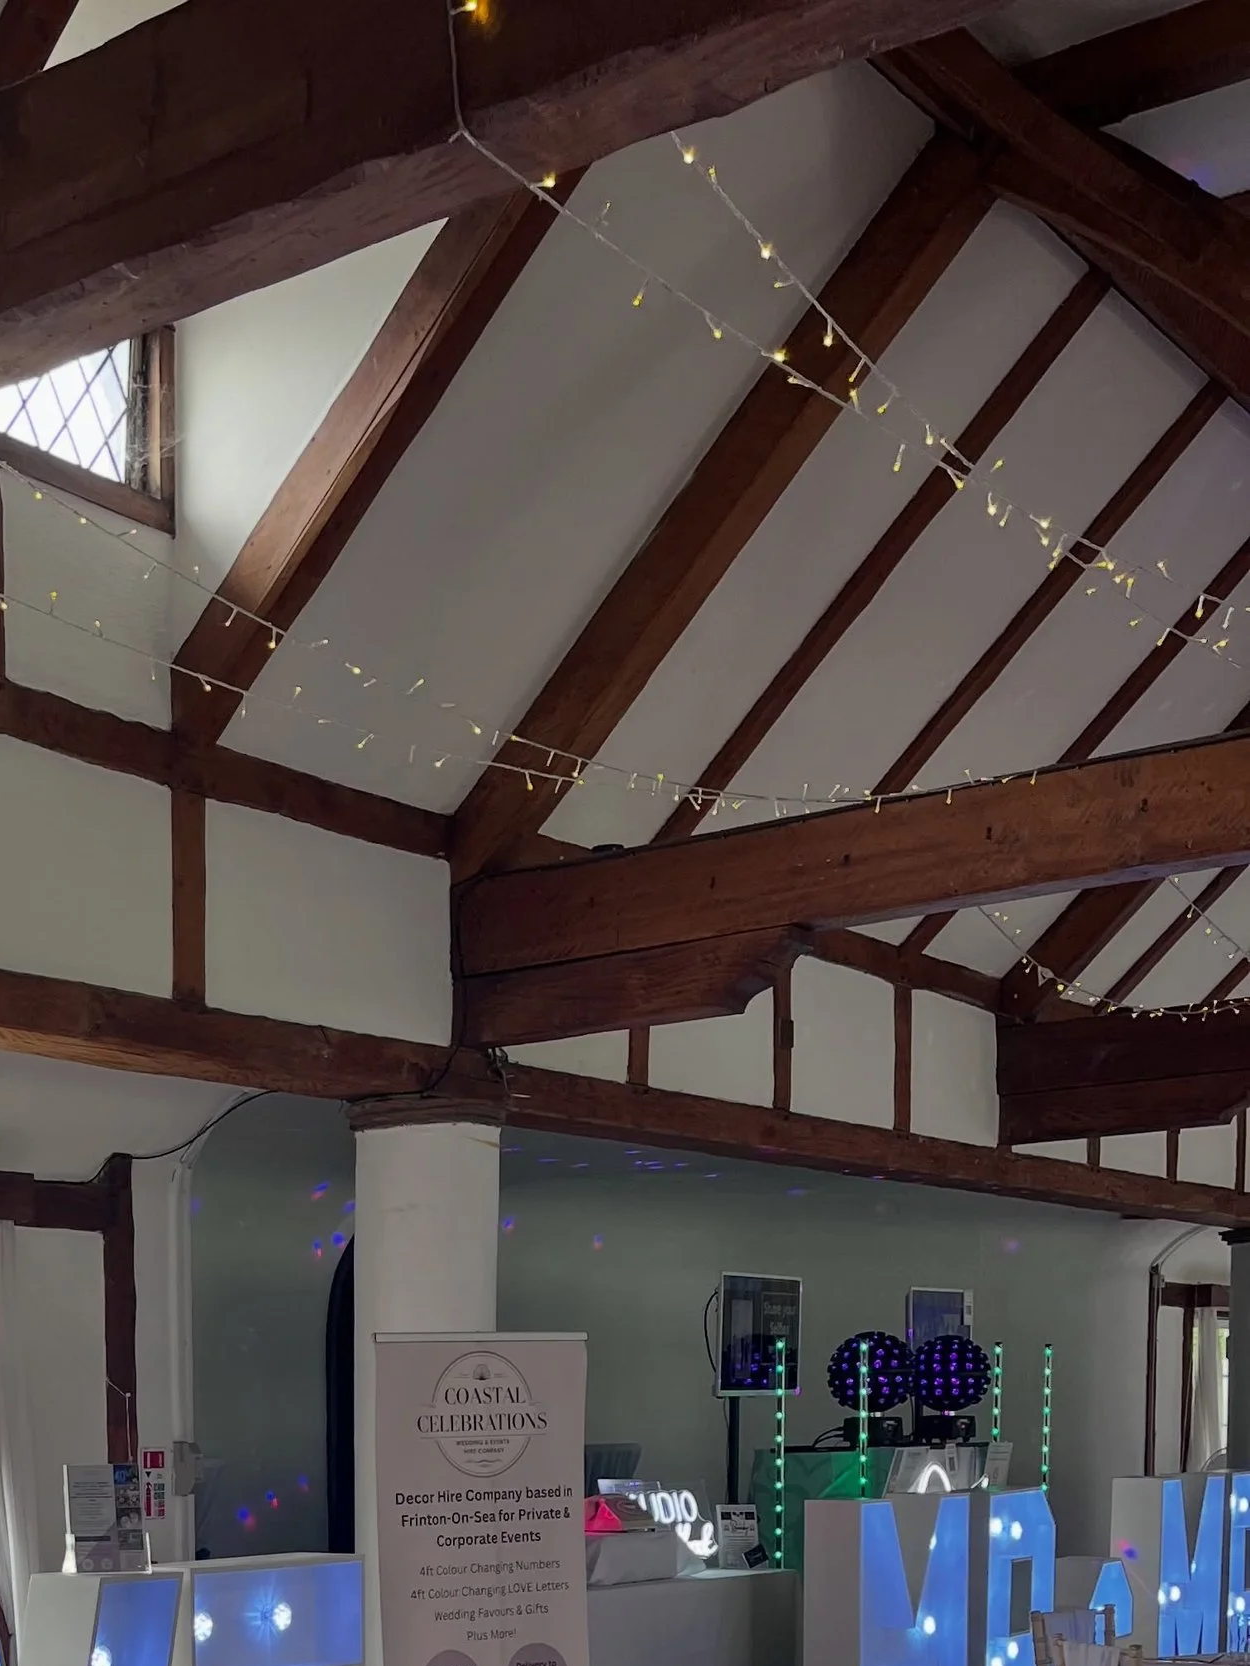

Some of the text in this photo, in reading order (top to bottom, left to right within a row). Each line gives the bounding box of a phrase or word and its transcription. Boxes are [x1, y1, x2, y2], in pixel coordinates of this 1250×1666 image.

[444, 1386, 527, 1405] COASTAL
[417, 1412, 548, 1434] CELEBRATIONS
[395, 1485, 572, 1505] Decor Hire Company based in
[401, 1507, 571, 1527] Frinton-On-Sea for Private &
[436, 1531, 541, 1549] Corporate Events
[419, 1559, 561, 1576] 4ft Colour Changing Numbers
[411, 1581, 570, 1600] 4ft Colour Changing LOVE Letters
[434, 1603, 549, 1622] Wedding Favours & Gifts
[467, 1628, 517, 1641] Plus More!
